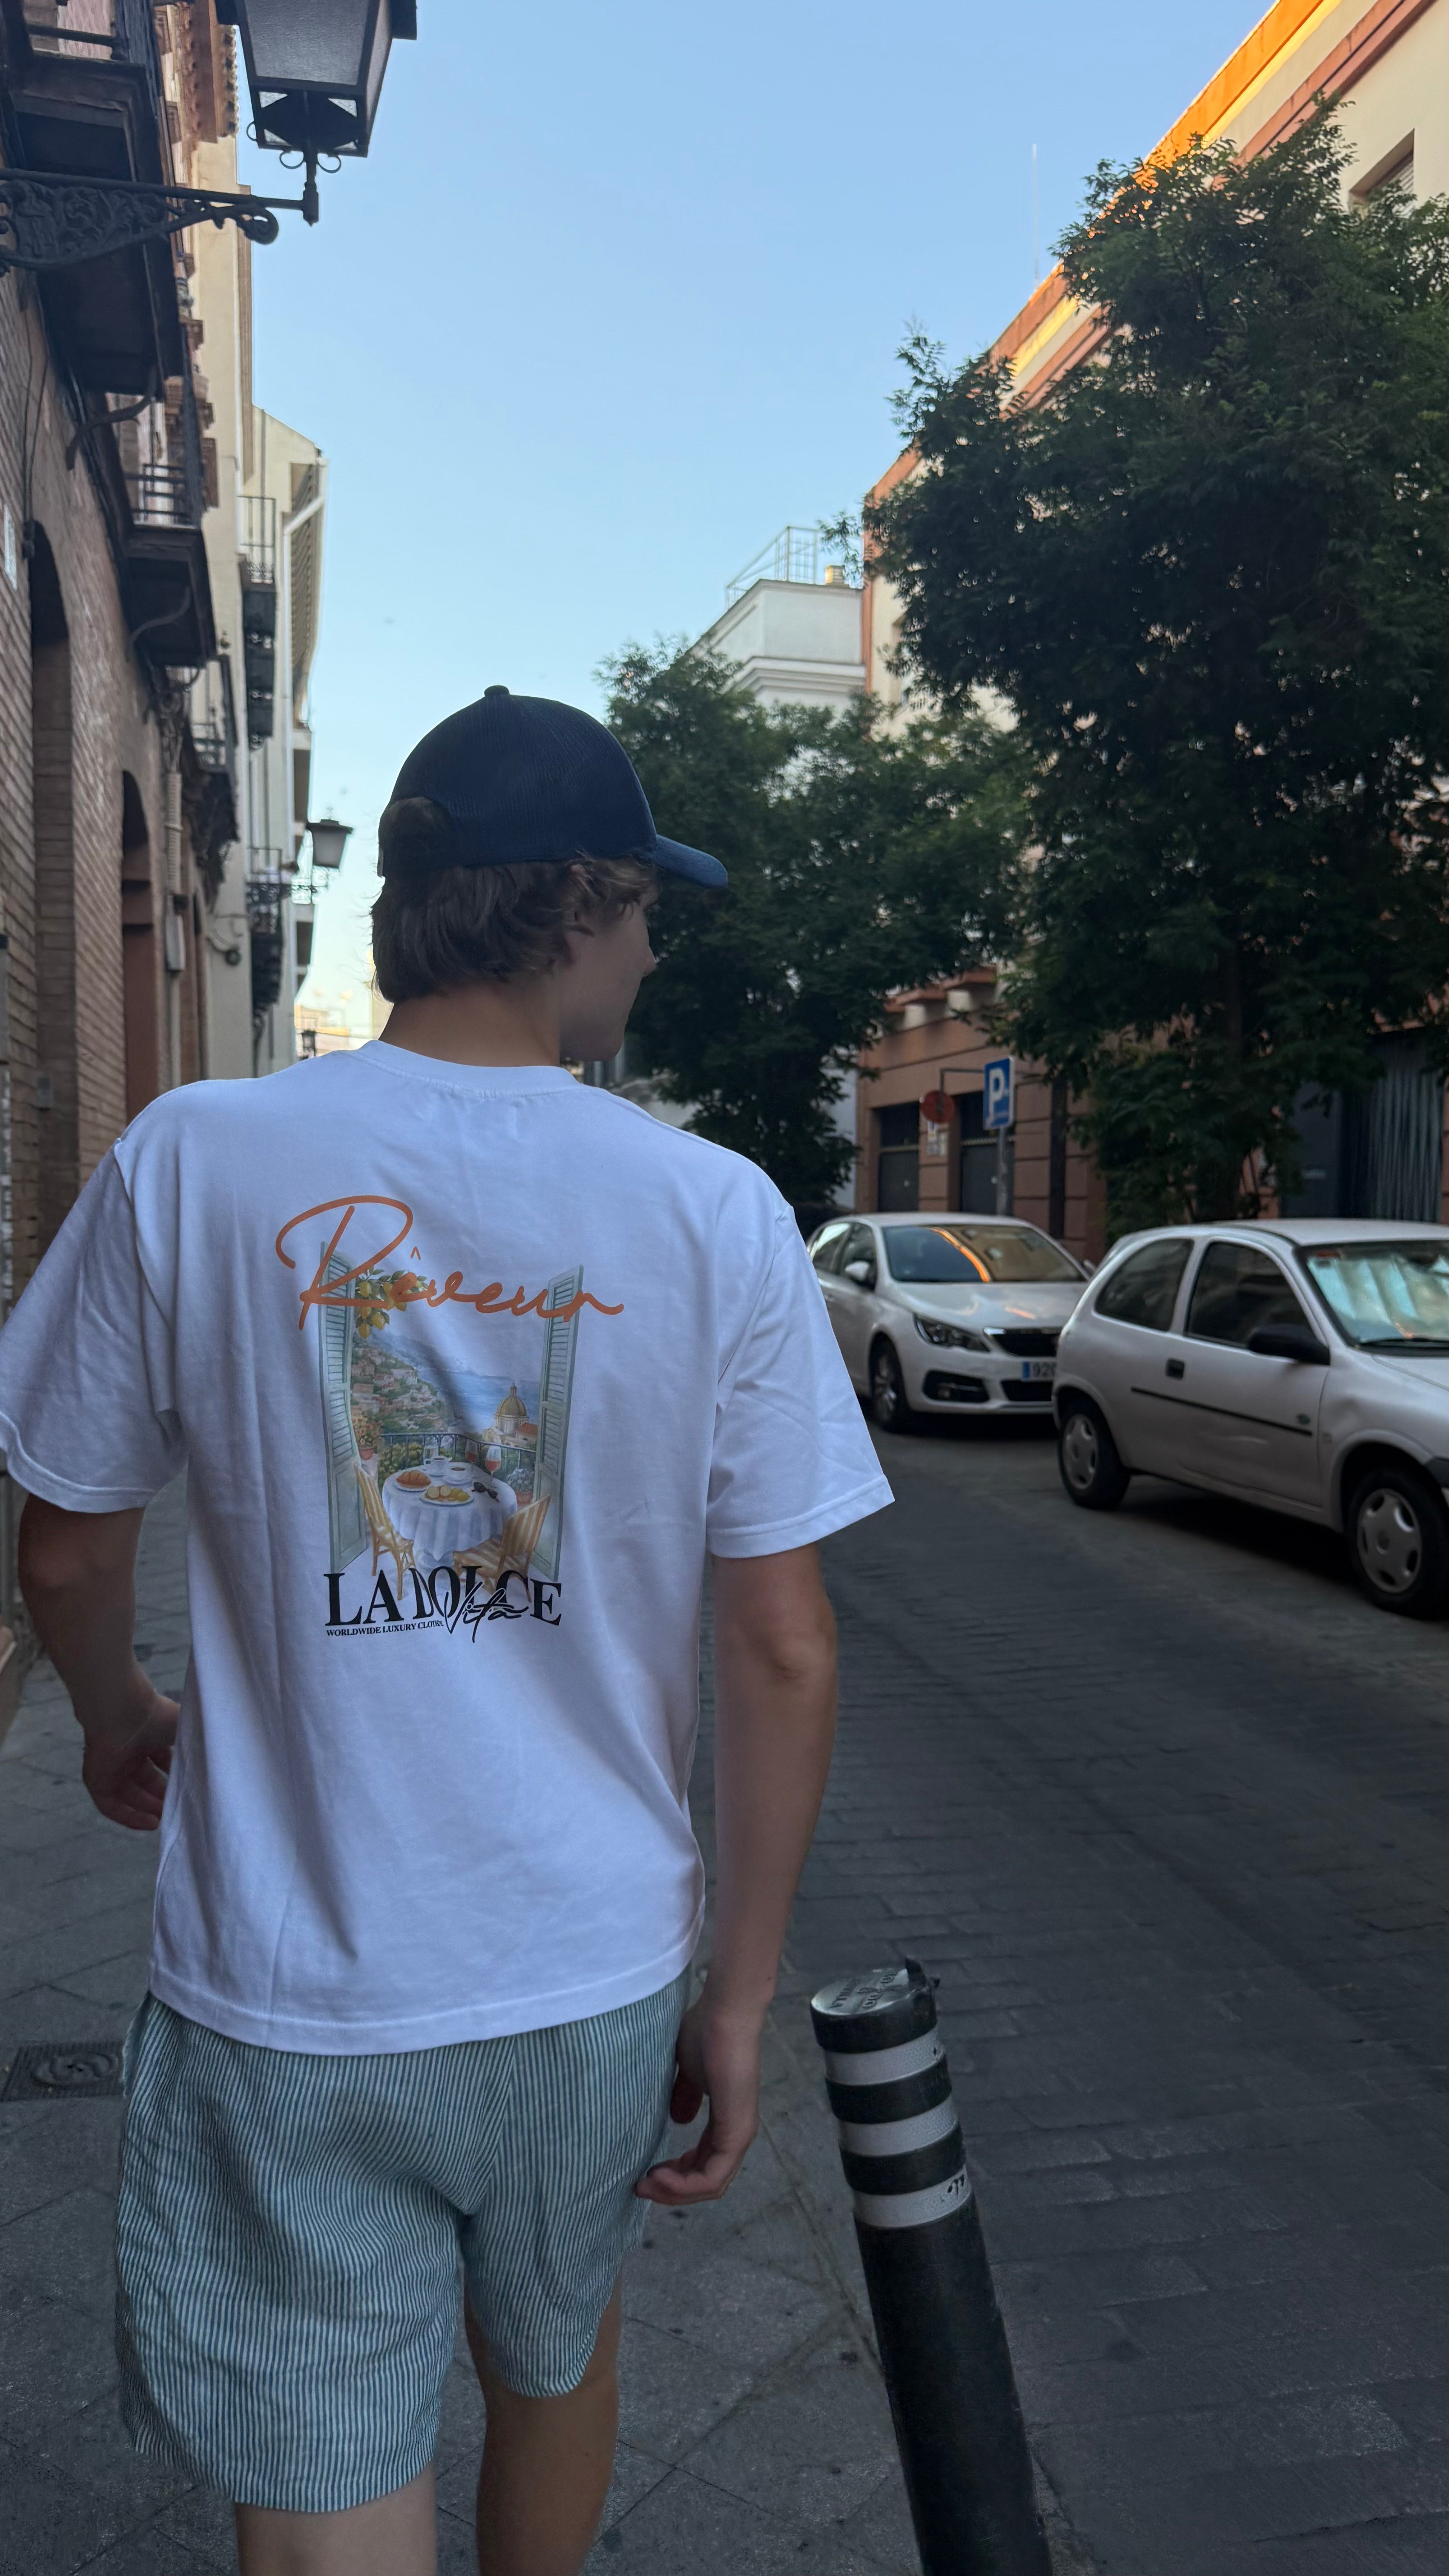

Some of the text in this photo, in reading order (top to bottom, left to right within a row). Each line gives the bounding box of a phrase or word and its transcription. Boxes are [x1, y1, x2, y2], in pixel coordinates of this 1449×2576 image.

[989, 1067, 1004, 1119] P
[327, 1627, 382, 1637] WORLDWIDE
[383, 1623, 416, 1633] LUXURY
[444, 1581, 529, 1643] Vita
